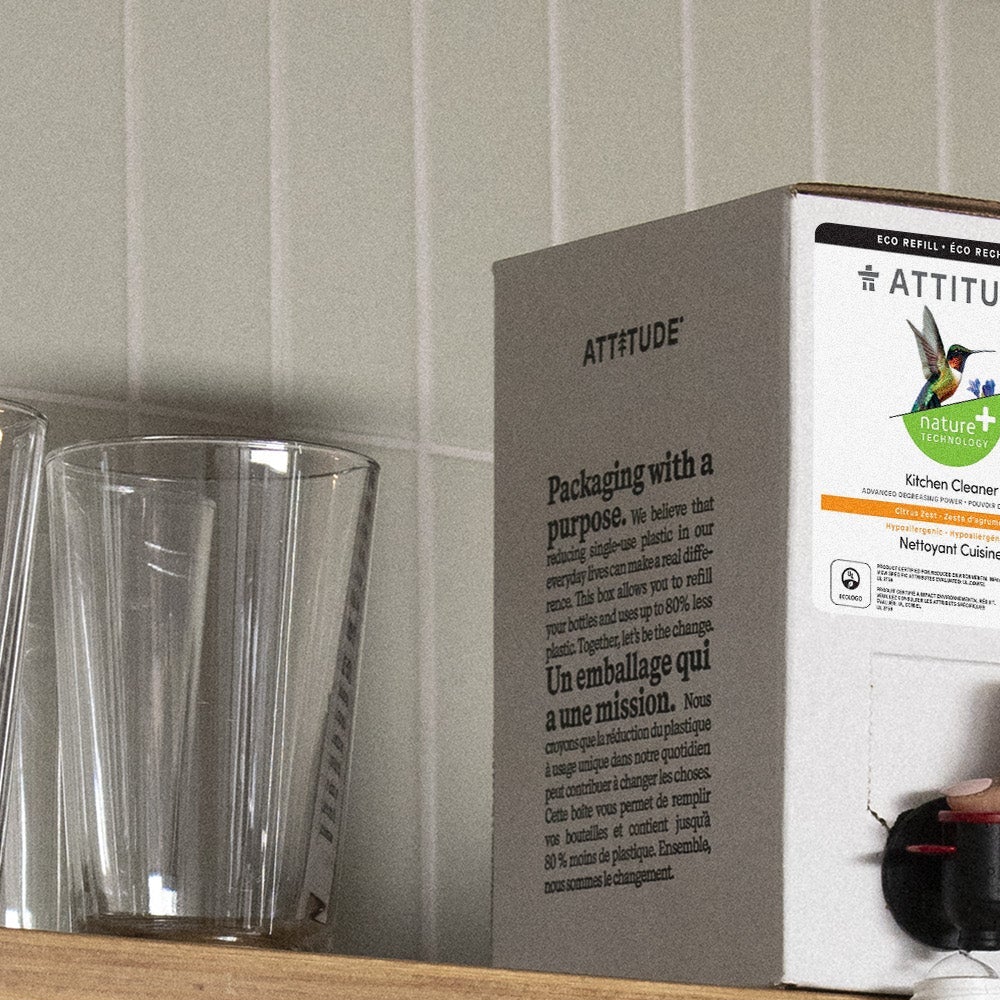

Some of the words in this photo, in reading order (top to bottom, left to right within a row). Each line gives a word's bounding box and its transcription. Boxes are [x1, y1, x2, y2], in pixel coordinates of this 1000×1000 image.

[877, 234, 899, 246] ECO
[902, 238, 938, 251] REFILL
[950, 241, 971, 255] ÉCO
[921, 432, 988, 448] TECHNOLOGY
[548, 461, 645, 505] Packaging
[648, 449, 696, 485] with
[700, 452, 714, 476] a
[905, 473, 948, 490] Kitchen
[951, 478, 999, 496] Cleaner
[547, 507, 626, 550] purpose.
[630, 507, 647, 525] We
[650, 502, 688, 522] believe
[691, 496, 715, 514] that
[920, 509, 937, 519] Zest
[546, 546, 587, 567] reducing
[589, 537, 637, 559] single-use
[640, 527, 674, 552] plastic
[677, 524, 690, 541] in
[694, 522, 715, 538] our
[587, 564, 610, 582] lives
[609, 562, 627, 577] can
[627, 554, 655, 574] make
[654, 555, 661, 569] a
[661, 548, 682, 568] real
[683, 543, 714, 564] diffe-
[899, 536, 957, 556] Nettoyant
[574, 589, 595, 607] This
[597, 587, 615, 604] box
[617, 582, 648, 599] allows
[649, 577, 669, 597] you
[671, 575, 684, 590] to
[686, 566, 713, 587] refill
[545, 621, 567, 640] your
[567, 613, 598, 633] bottles
[598, 608, 617, 627] and
[618, 607, 639, 623] uses
[639, 605, 653, 623] up
[653, 602, 665, 617] to
[665, 595, 691, 615] 80%
[692, 595, 713, 610] less
[577, 633, 621, 656] Together,
[641, 626, 654, 643] be
[654, 623, 671, 640] the
[672, 619, 714, 638] change.
[545, 664, 573, 696] Un
[576, 652, 672, 690] emballage
[675, 639, 711, 682] qui
[545, 709, 557, 732] a
[559, 704, 592, 729] une
[595, 684, 676, 723] mission.
[683, 692, 712, 710] Nous
[580, 735, 597, 753] que
[596, 731, 606, 747] la
[605, 725, 650, 745] réduction
[650, 721, 664, 738] du
[663, 717, 712, 741] plastique
[552, 761, 577, 779] usage
[578, 756, 610, 774] unique
[610, 752, 633, 768] dans
[634, 749, 660, 765] notre
[661, 740, 711, 764] quotidien
[565, 779, 612, 798] contribuer
[612, 775, 620, 791] à
[619, 773, 658, 791] changer
[658, 769, 673, 785] les
[673, 766, 712, 783] choses.
[544, 807, 569, 824] Cette
[595, 802, 618, 817] vous
[619, 796, 654, 818] permet
[655, 792, 669, 809] de
[671, 787, 712, 809] remplir
[544, 833, 561, 847] vos
[565, 824, 609, 844] bouteilles
[613, 823, 624, 838] et
[628, 817, 669, 837] contient
[544, 853, 557, 871] 80
[569, 850, 597, 867] moins
[598, 847, 610, 864] de
[611, 843, 657, 866] plastique.
[658, 835, 712, 857] Ensemble,
[544, 879, 566, 894] nous
[566, 875, 603, 892] sommes
[603, 870, 613, 887] le
[612, 865, 674, 888] changement.
